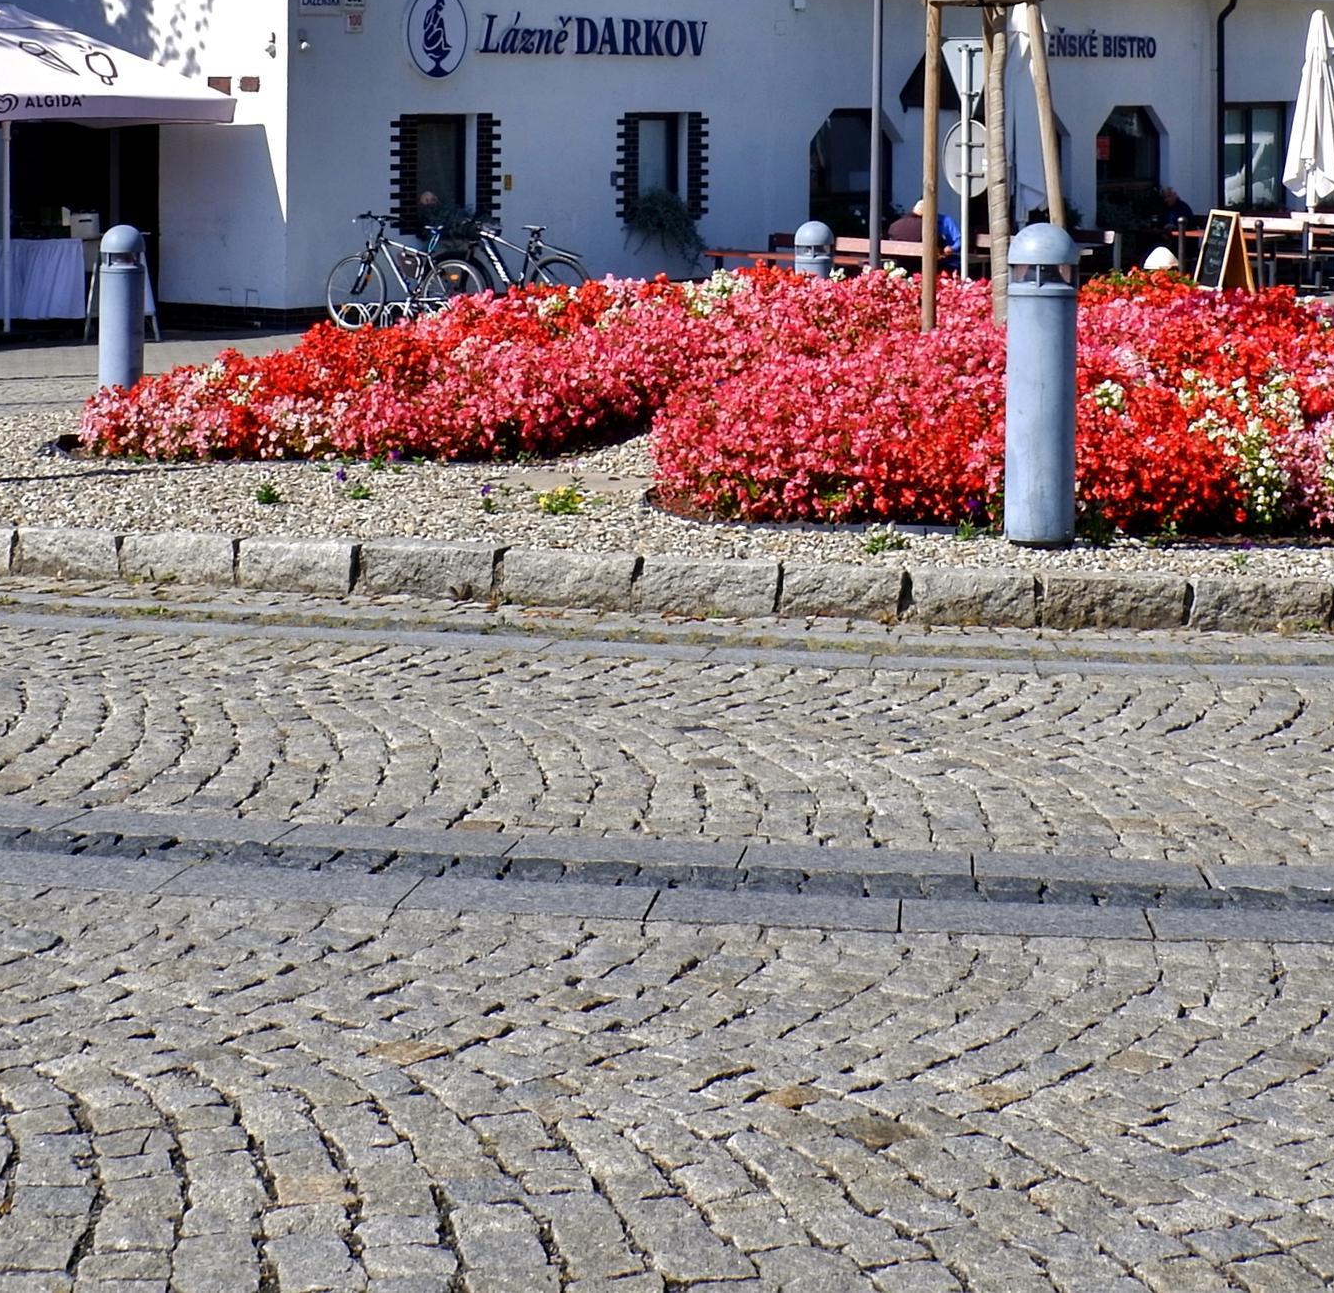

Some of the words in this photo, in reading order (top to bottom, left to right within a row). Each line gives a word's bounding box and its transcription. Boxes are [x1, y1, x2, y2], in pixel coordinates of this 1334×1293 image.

[478, 11, 572, 55] Lázně
[574, 16, 708, 57] DARKOV
[1047, 27, 1098, 58] EŇSKÉ
[1102, 35, 1157, 58] BISTRO
[24, 94, 82, 108] ALGIDA
